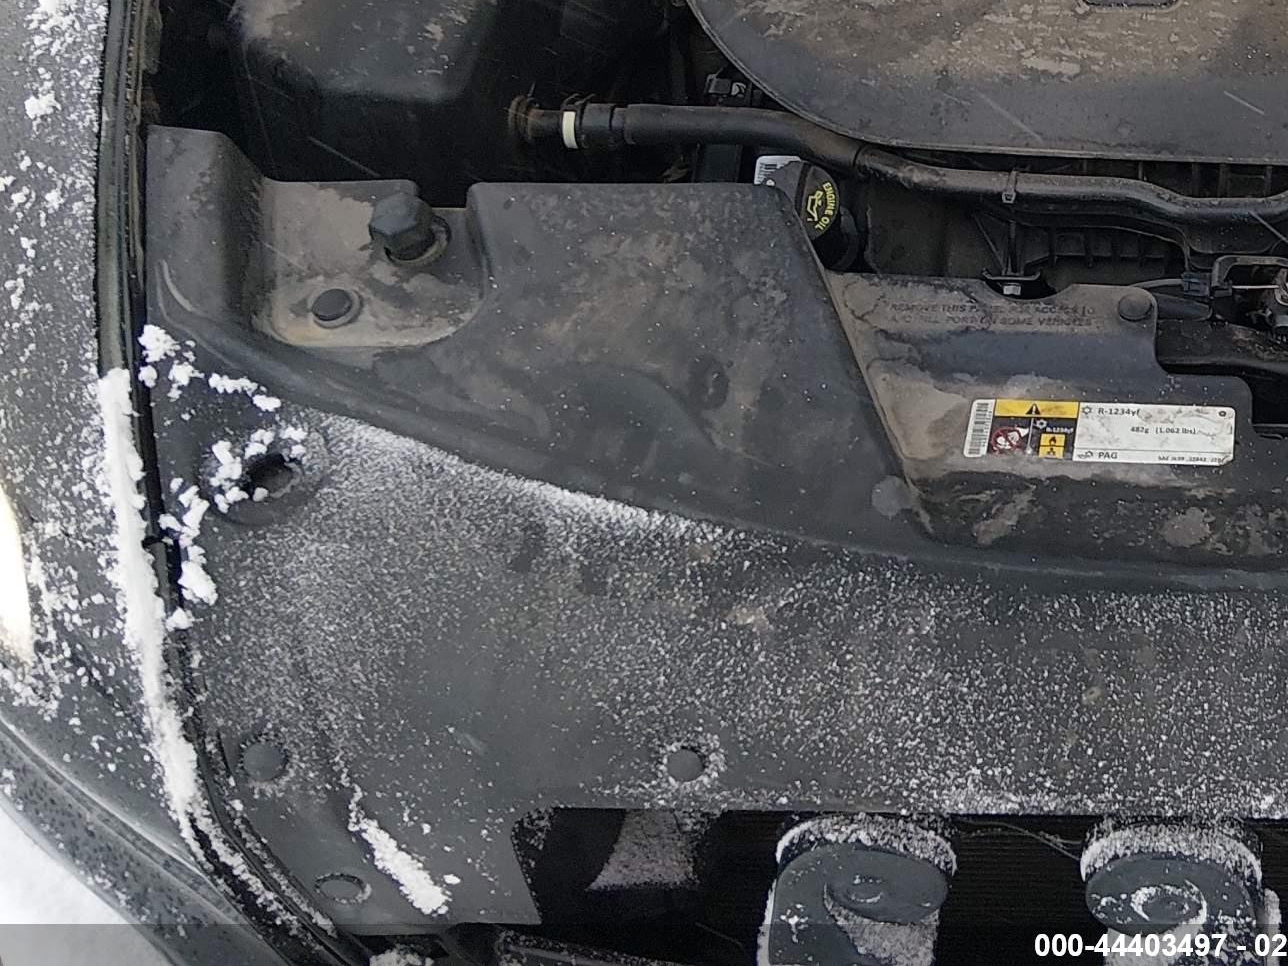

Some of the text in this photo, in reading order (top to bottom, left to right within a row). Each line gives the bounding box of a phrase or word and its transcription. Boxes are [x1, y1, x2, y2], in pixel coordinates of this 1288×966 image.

[815, 182, 836, 231] ENGINE OIL
[1098, 407, 1141, 417] R-1234yf
[1098, 451, 1118, 460] PAG
